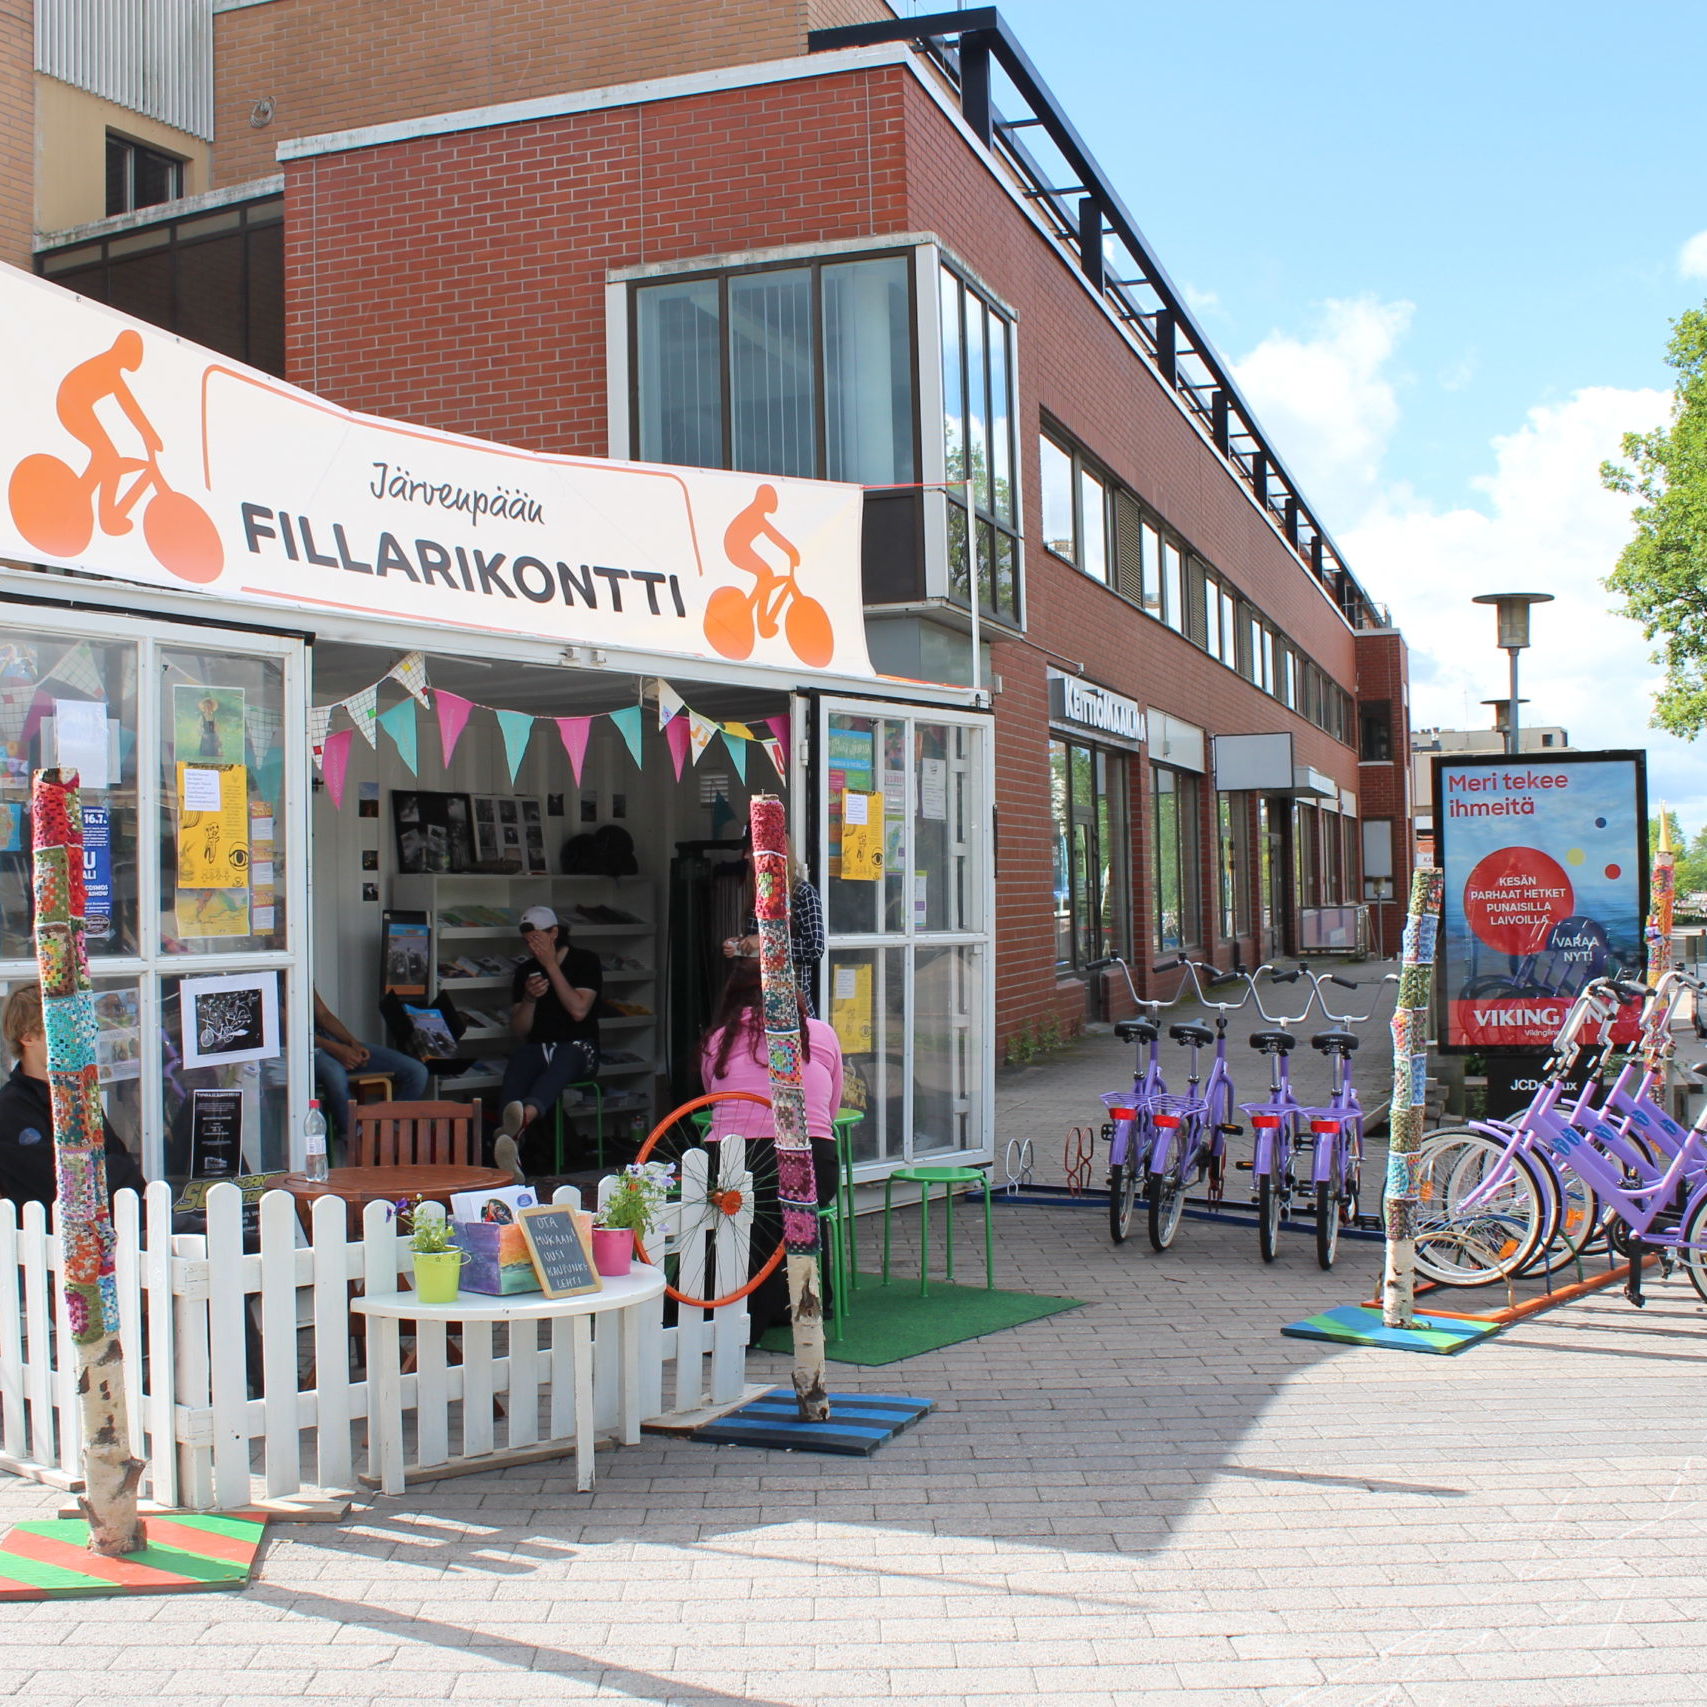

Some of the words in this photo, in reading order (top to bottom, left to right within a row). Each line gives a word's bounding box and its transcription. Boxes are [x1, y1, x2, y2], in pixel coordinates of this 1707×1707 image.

[370, 462, 545, 526] Järvenpään
[241, 501, 687, 618] FILLARIKONTTI
[1448, 772, 1498, 793] Meri
[1502, 770, 1569, 791] tekee
[1448, 796, 1535, 818] ihmeitä
[83, 813, 108, 825] 16.7.
[1499, 874, 1537, 887] KESÄN
[1470, 889, 1522, 901] PARHAAT
[1524, 887, 1566, 899] HETKET
[1486, 902, 1552, 913] PUNAISILLA
[1490, 914, 1550, 926] LAIVOILLA
[1555, 936, 1600, 949] VARAA
[1563, 950, 1593, 962] NYT!
[1473, 1008, 1560, 1027] VIKING
[1510, 1079, 1578, 1091] JCDux
[536, 1216, 559, 1229] OTA
